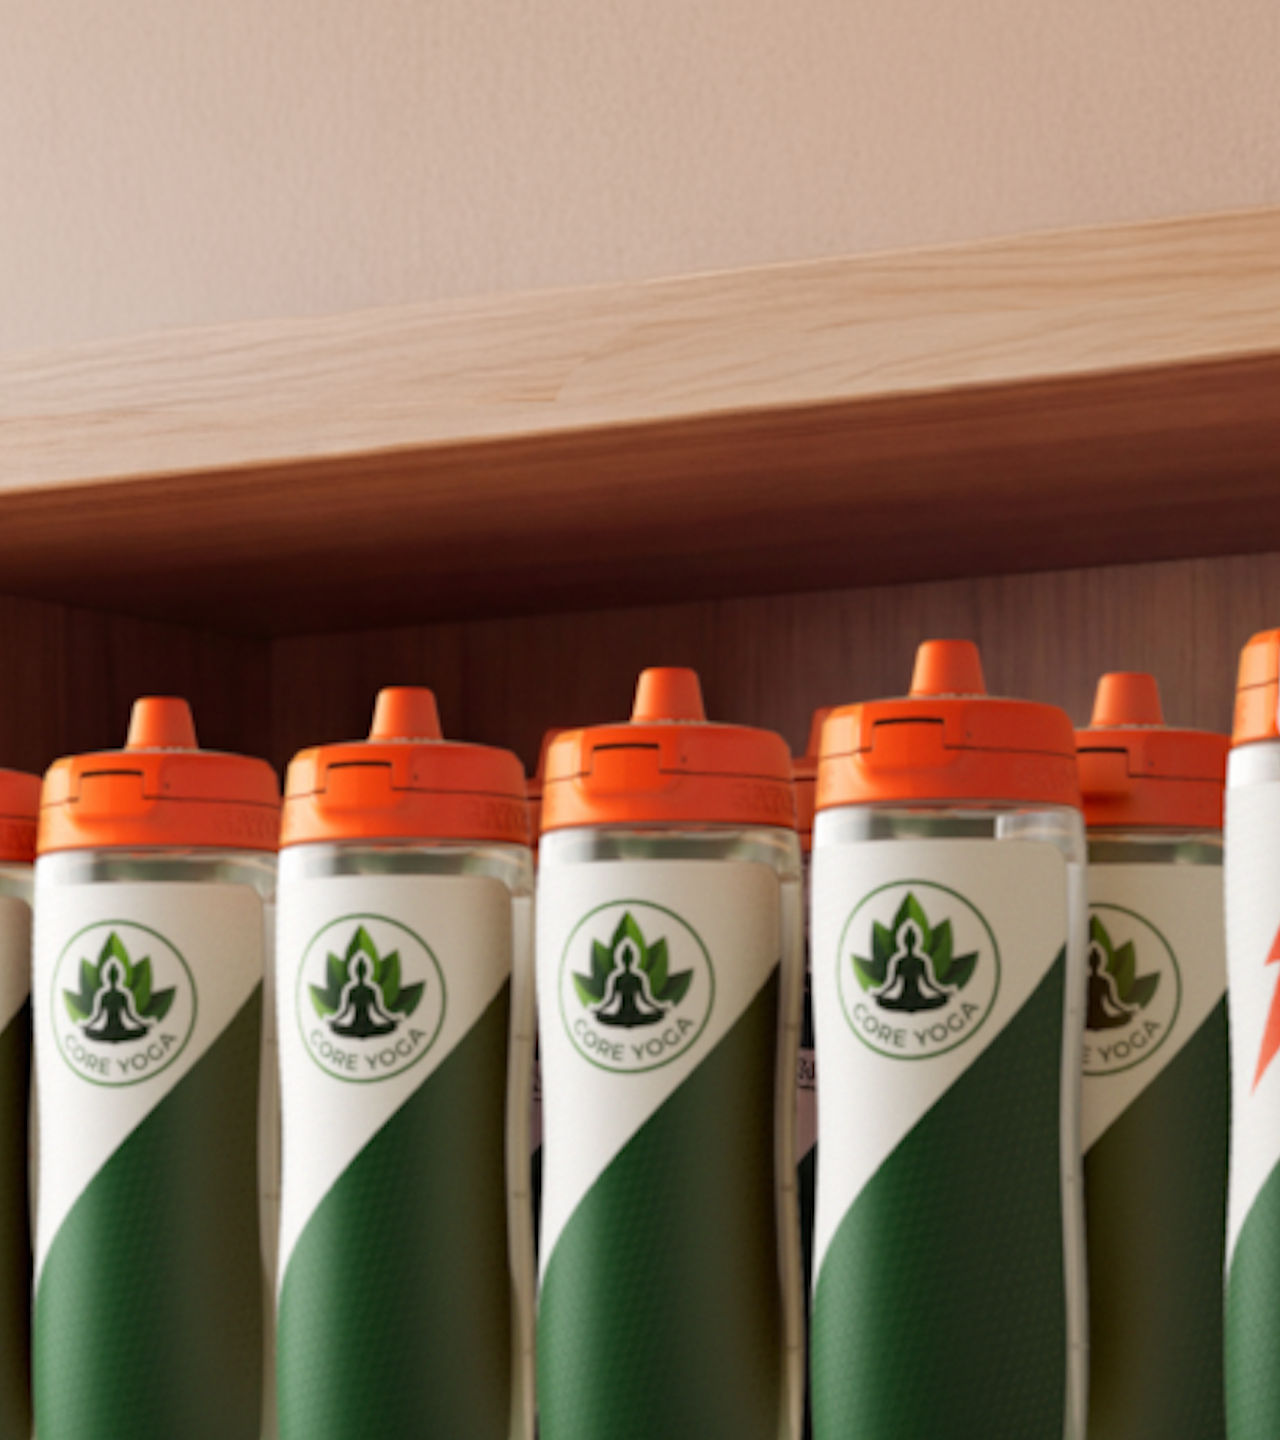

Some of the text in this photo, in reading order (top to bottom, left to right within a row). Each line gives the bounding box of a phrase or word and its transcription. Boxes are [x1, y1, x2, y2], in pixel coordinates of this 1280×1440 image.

[574, 1017, 694, 1060] CORE YOGA
[853, 1002, 979, 1047] CORE YOGA
[1097, 1020, 1161, 1063] YOGA
[65, 1032, 177, 1075] CORE YOGA
[310, 1028, 427, 1071] CORE YOGA
